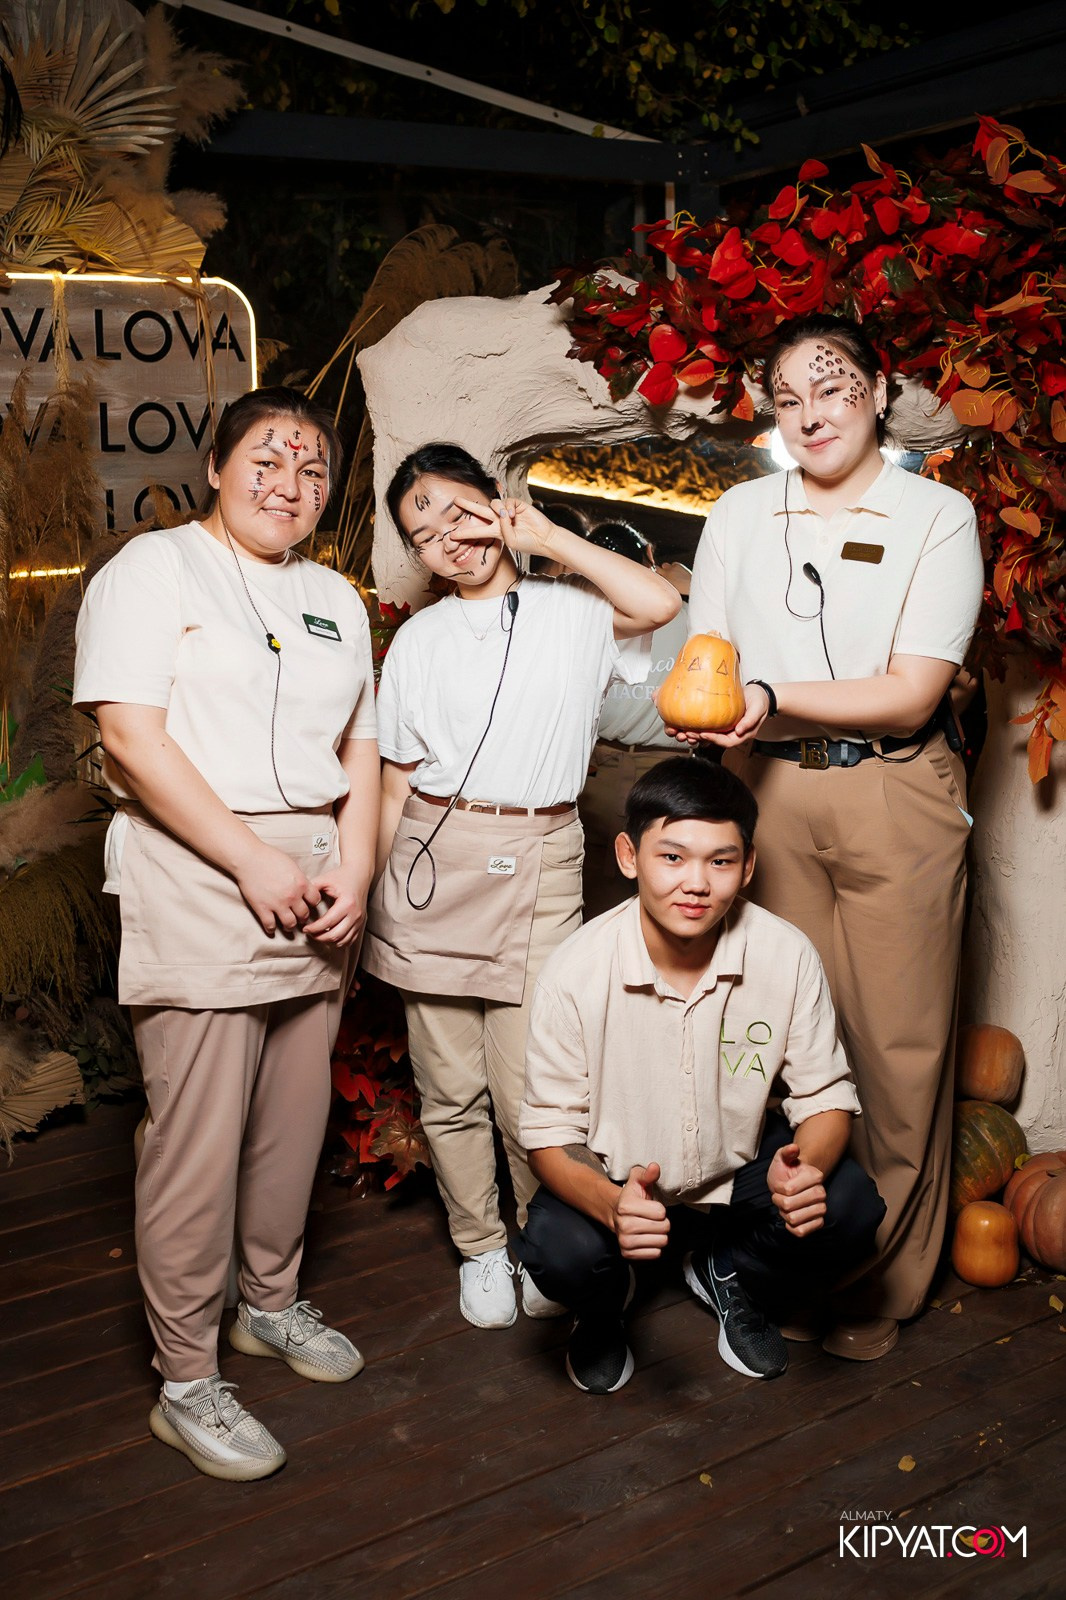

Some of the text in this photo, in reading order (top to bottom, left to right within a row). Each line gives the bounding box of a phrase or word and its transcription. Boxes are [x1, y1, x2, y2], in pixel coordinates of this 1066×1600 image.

[94, 308, 247, 363] LOVA
[99, 402, 230, 454] LOV
[720, 1017, 772, 1046] LO
[720, 1051, 768, 1083] VA
